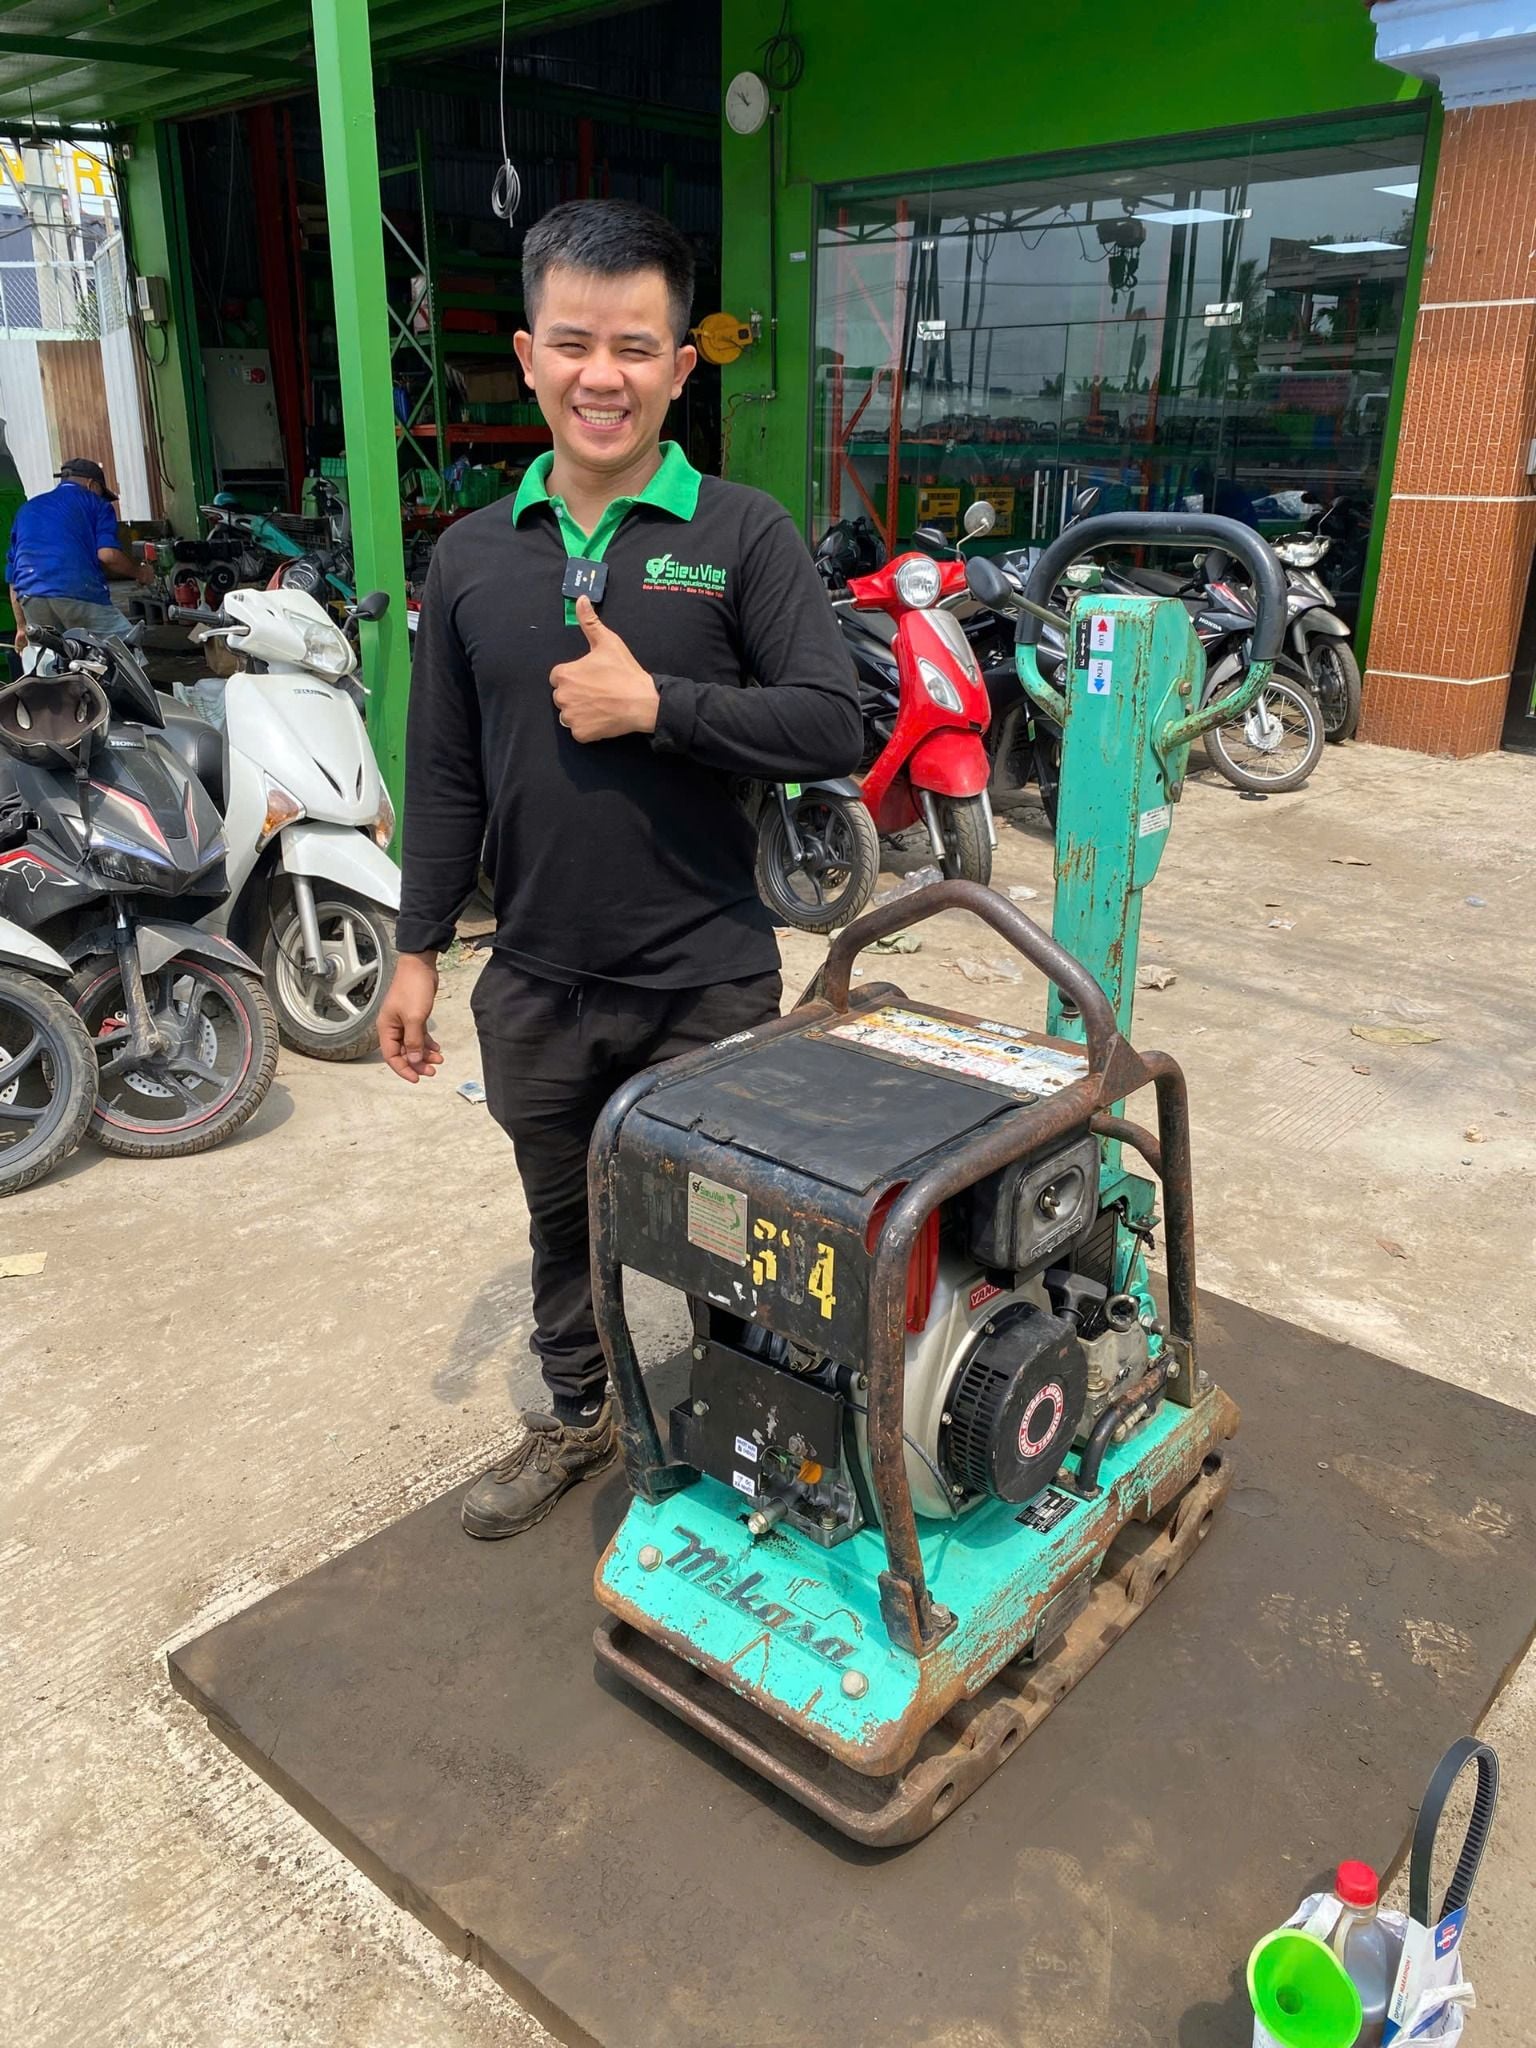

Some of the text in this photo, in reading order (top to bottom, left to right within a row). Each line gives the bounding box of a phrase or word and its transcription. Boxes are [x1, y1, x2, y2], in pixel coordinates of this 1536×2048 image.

[665, 561, 726, 584] SieuViet
[1199, 616, 1222, 632] HONDA
[1400, 1962, 1411, 1993] MARATHON
